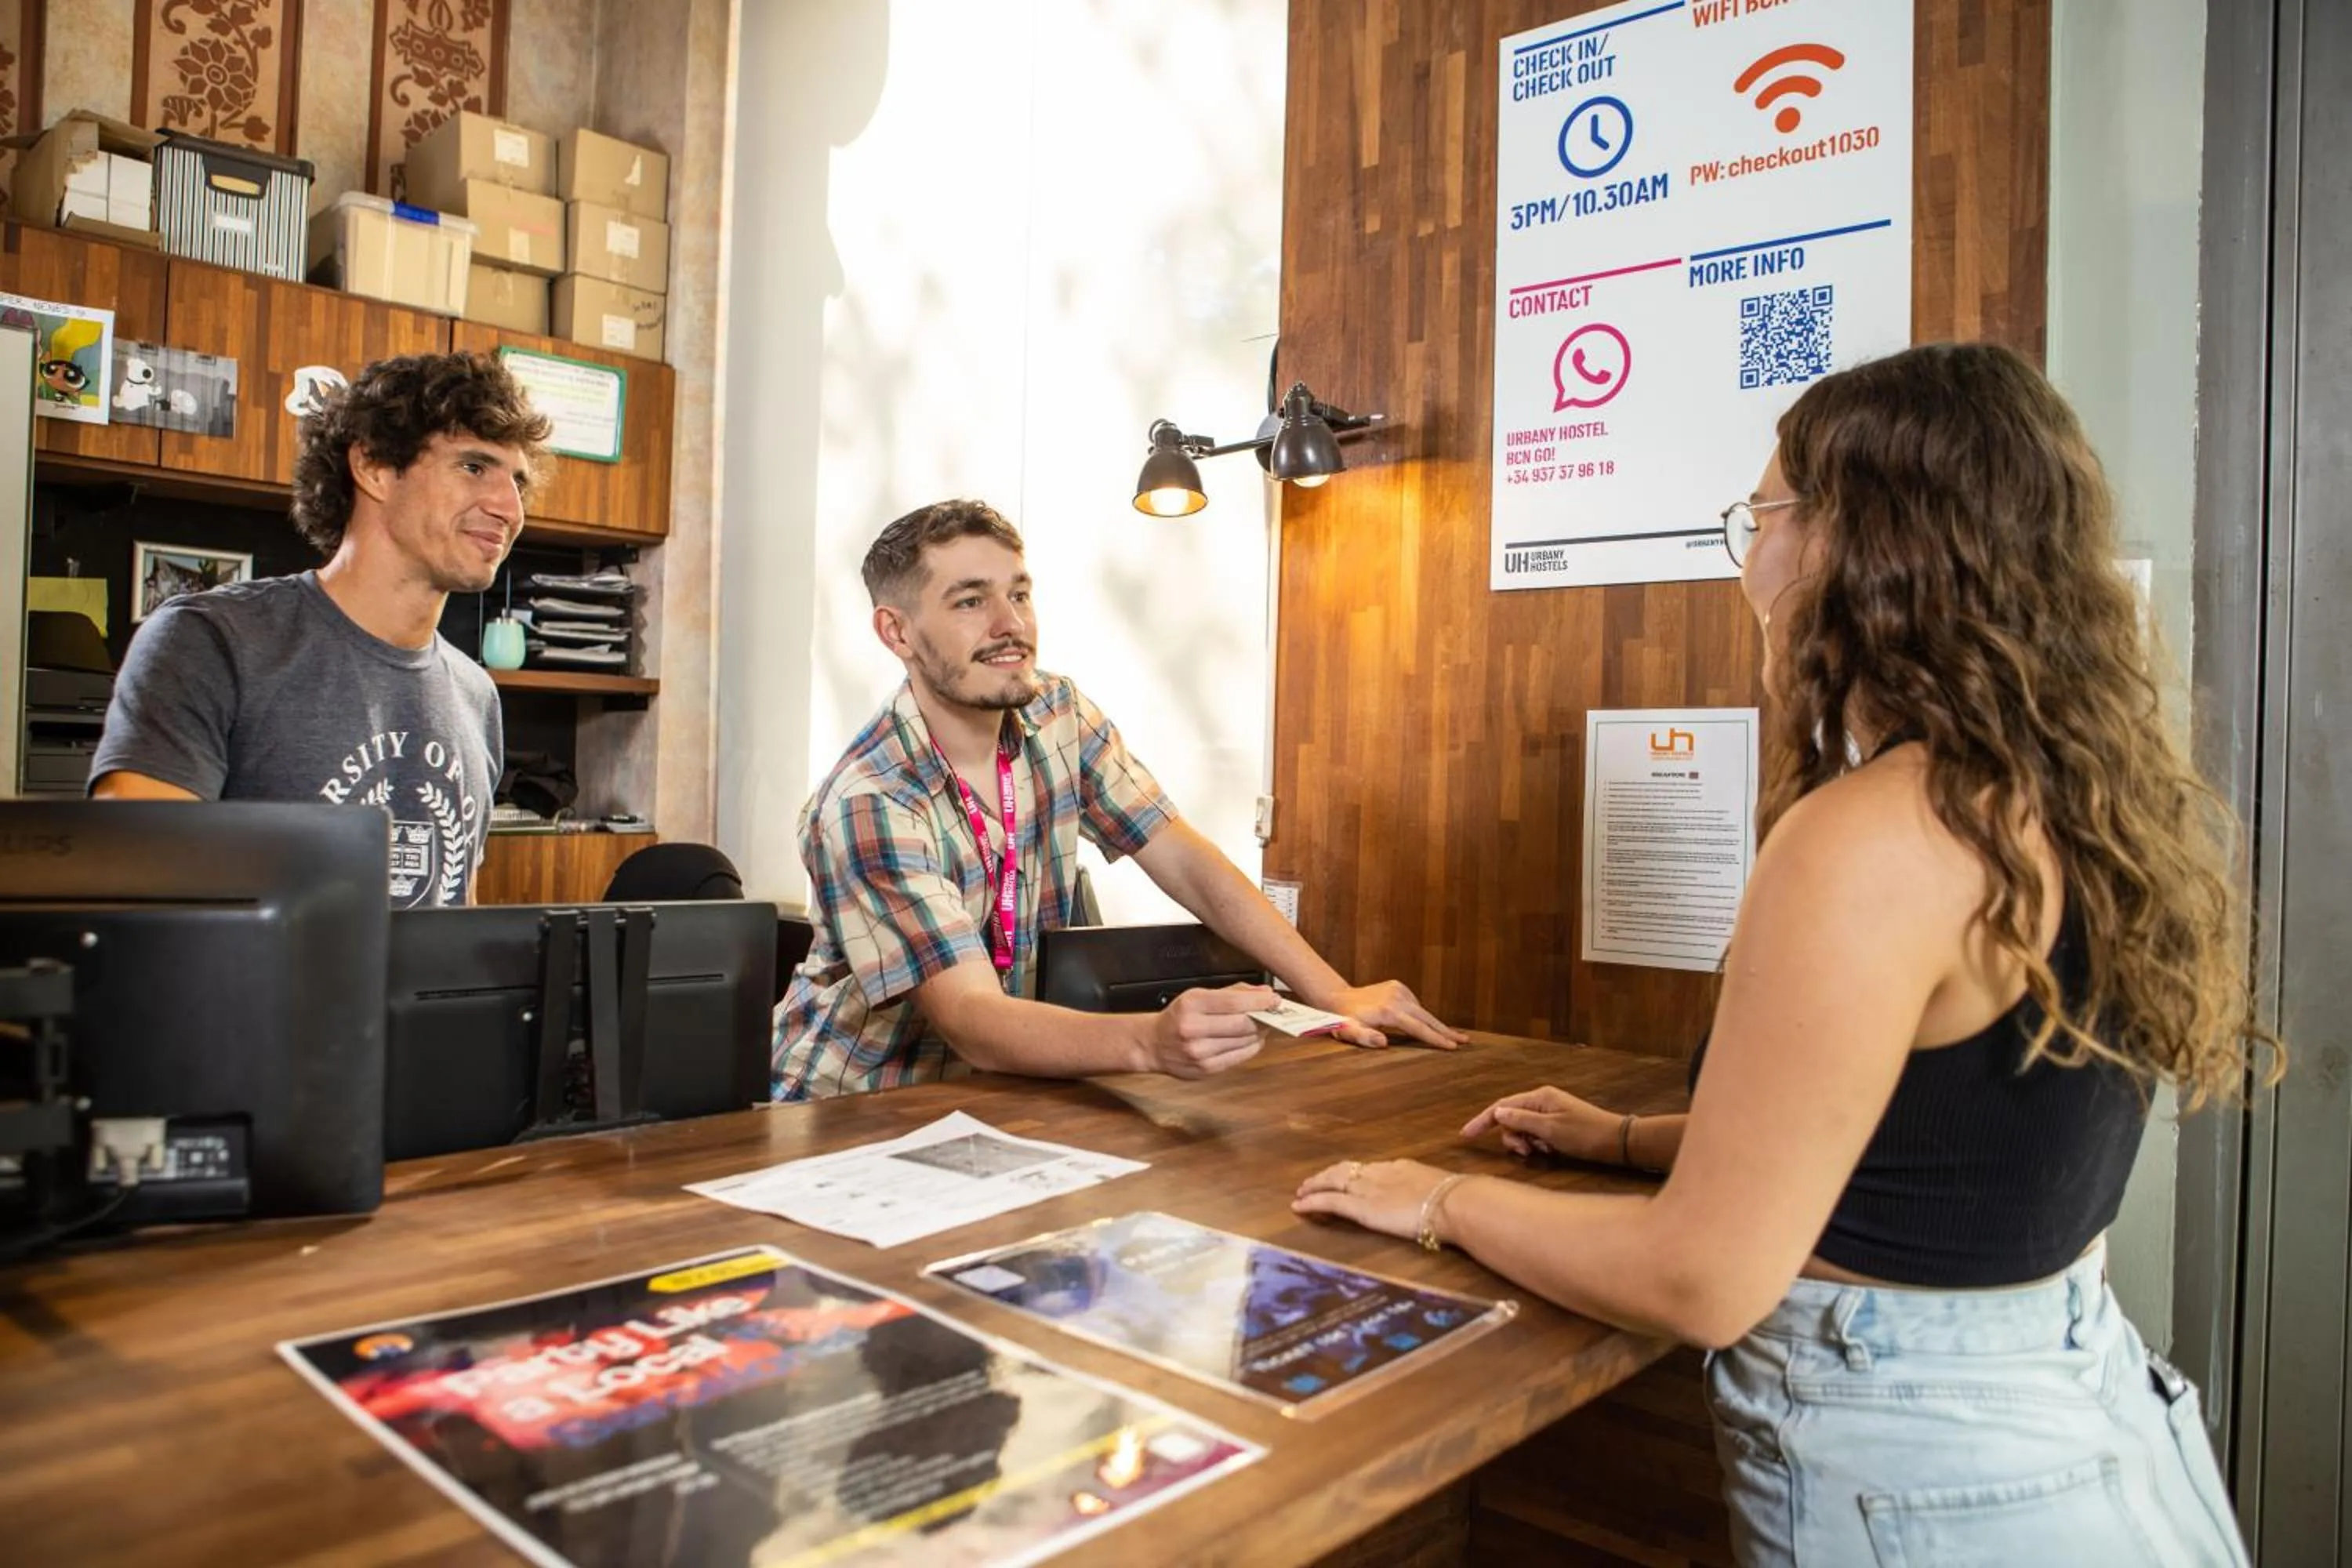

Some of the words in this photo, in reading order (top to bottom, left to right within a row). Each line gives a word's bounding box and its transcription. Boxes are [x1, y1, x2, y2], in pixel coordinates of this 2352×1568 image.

[1693, 0, 1739, 27] WIFI
[1513, 44, 1573, 78] CHECK
[1578, 31, 1609, 60] IN/
[1513, 67, 1573, 101] CHECK
[1578, 55, 1616, 84] OUT
[1511, 172, 1669, 230] 3PM/10.30AM
[1690, 256, 1747, 288] MORE
[1753, 247, 1804, 277] INFO
[1509, 285, 1593, 318] CONTACT
[1507, 427, 1555, 446] URBANY
[1559, 421, 1608, 441] HOSTEL
[1507, 450, 1530, 466] BCN
[1534, 446, 1555, 462] GO!
[1507, 469, 1528, 484] +34
[1532, 466, 1555, 482] 937
[1559, 464, 1574, 480] 37
[1578, 463, 1594, 477] 96
[1599, 460, 1614, 475] 18
[1504, 551, 1530, 573] UH
[1530, 550, 1565, 561] URBANY
[1530, 560, 1568, 572] HOSTELS
